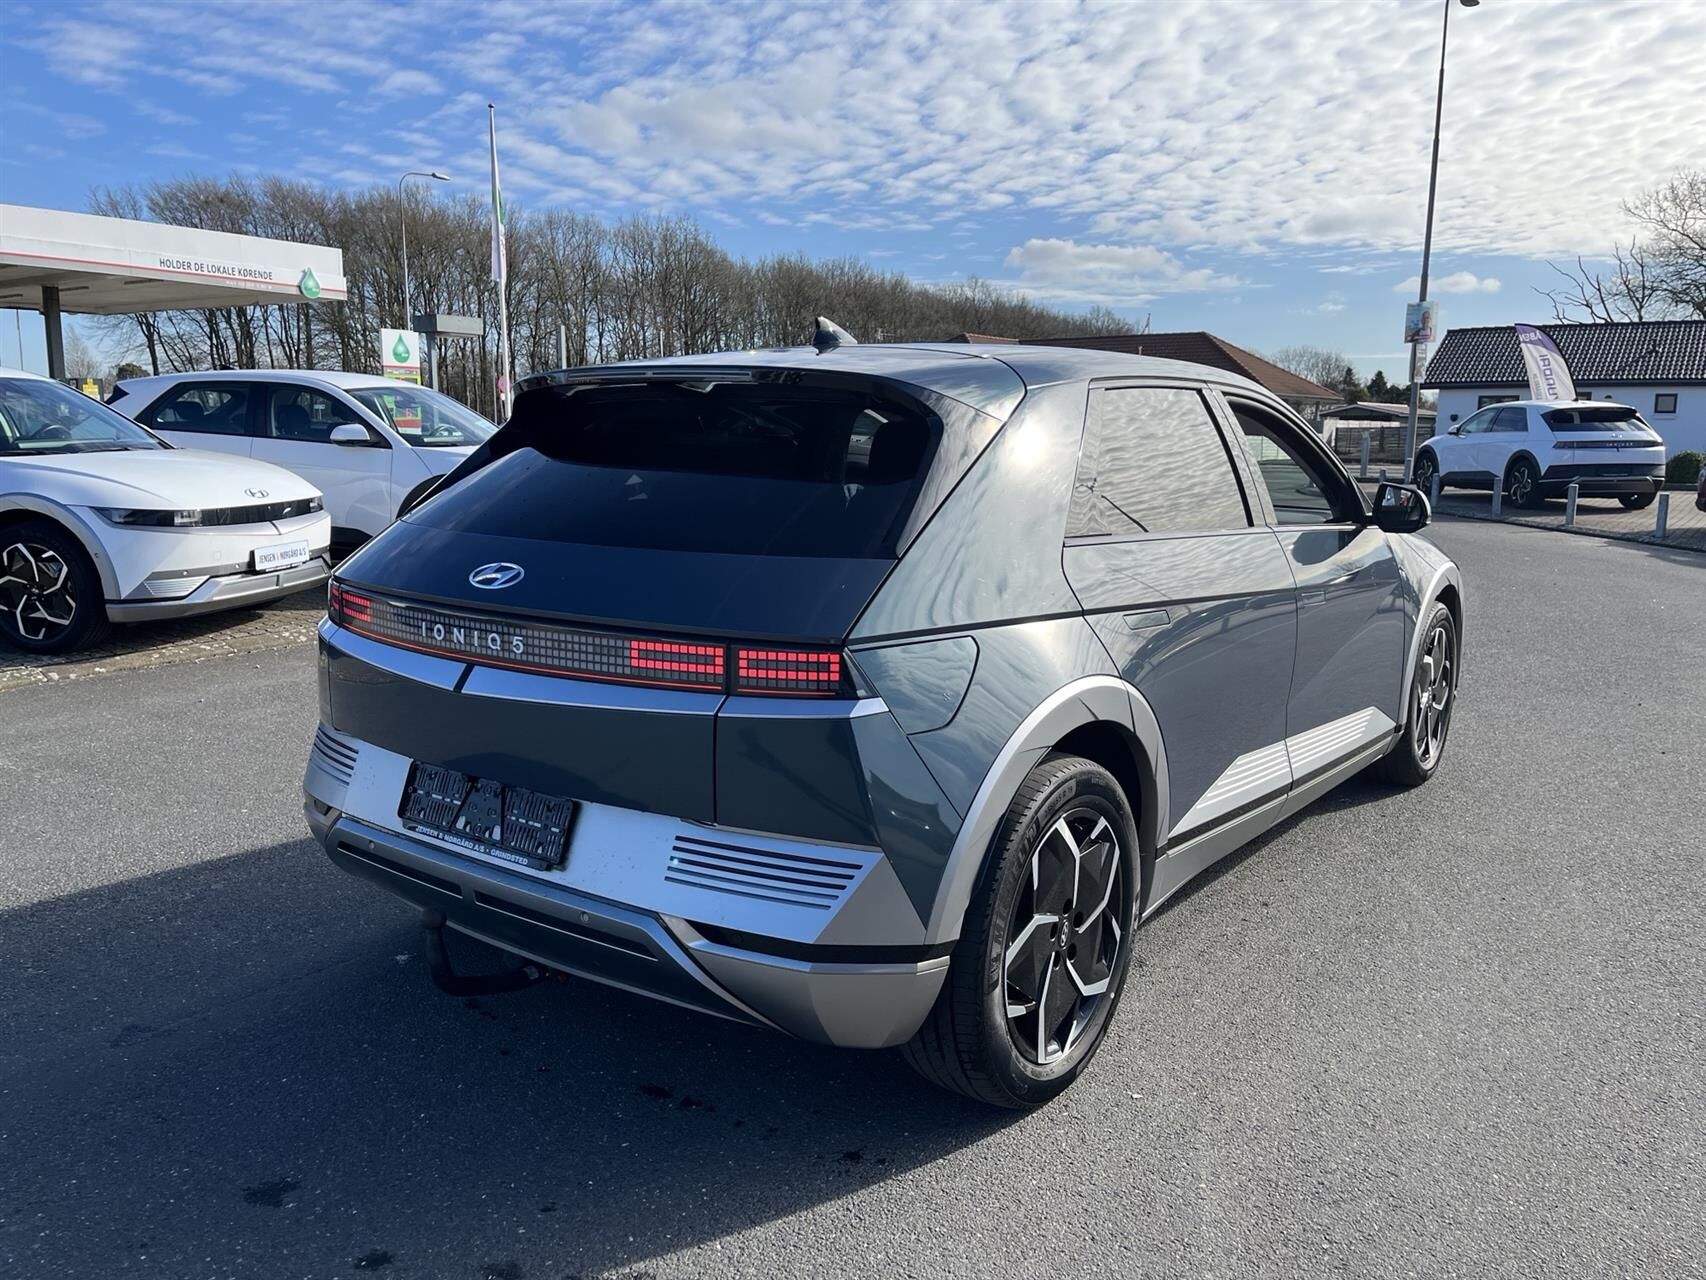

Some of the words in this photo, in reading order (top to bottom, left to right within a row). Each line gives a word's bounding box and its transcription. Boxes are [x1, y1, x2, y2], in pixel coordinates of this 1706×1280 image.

[160, 258, 192, 271] HOLDER
[194, 262, 204, 272] DE
[206, 263, 236, 276] LOKALE
[238, 268, 273, 280] KØRENDE
[422, 621, 501, 650] IONIQ
[512, 636, 524, 654] 5
[415, 825, 438, 838] JENSEN
[474, 842, 485, 853] A/S
[490, 849, 529, 865] GRINDSTED
